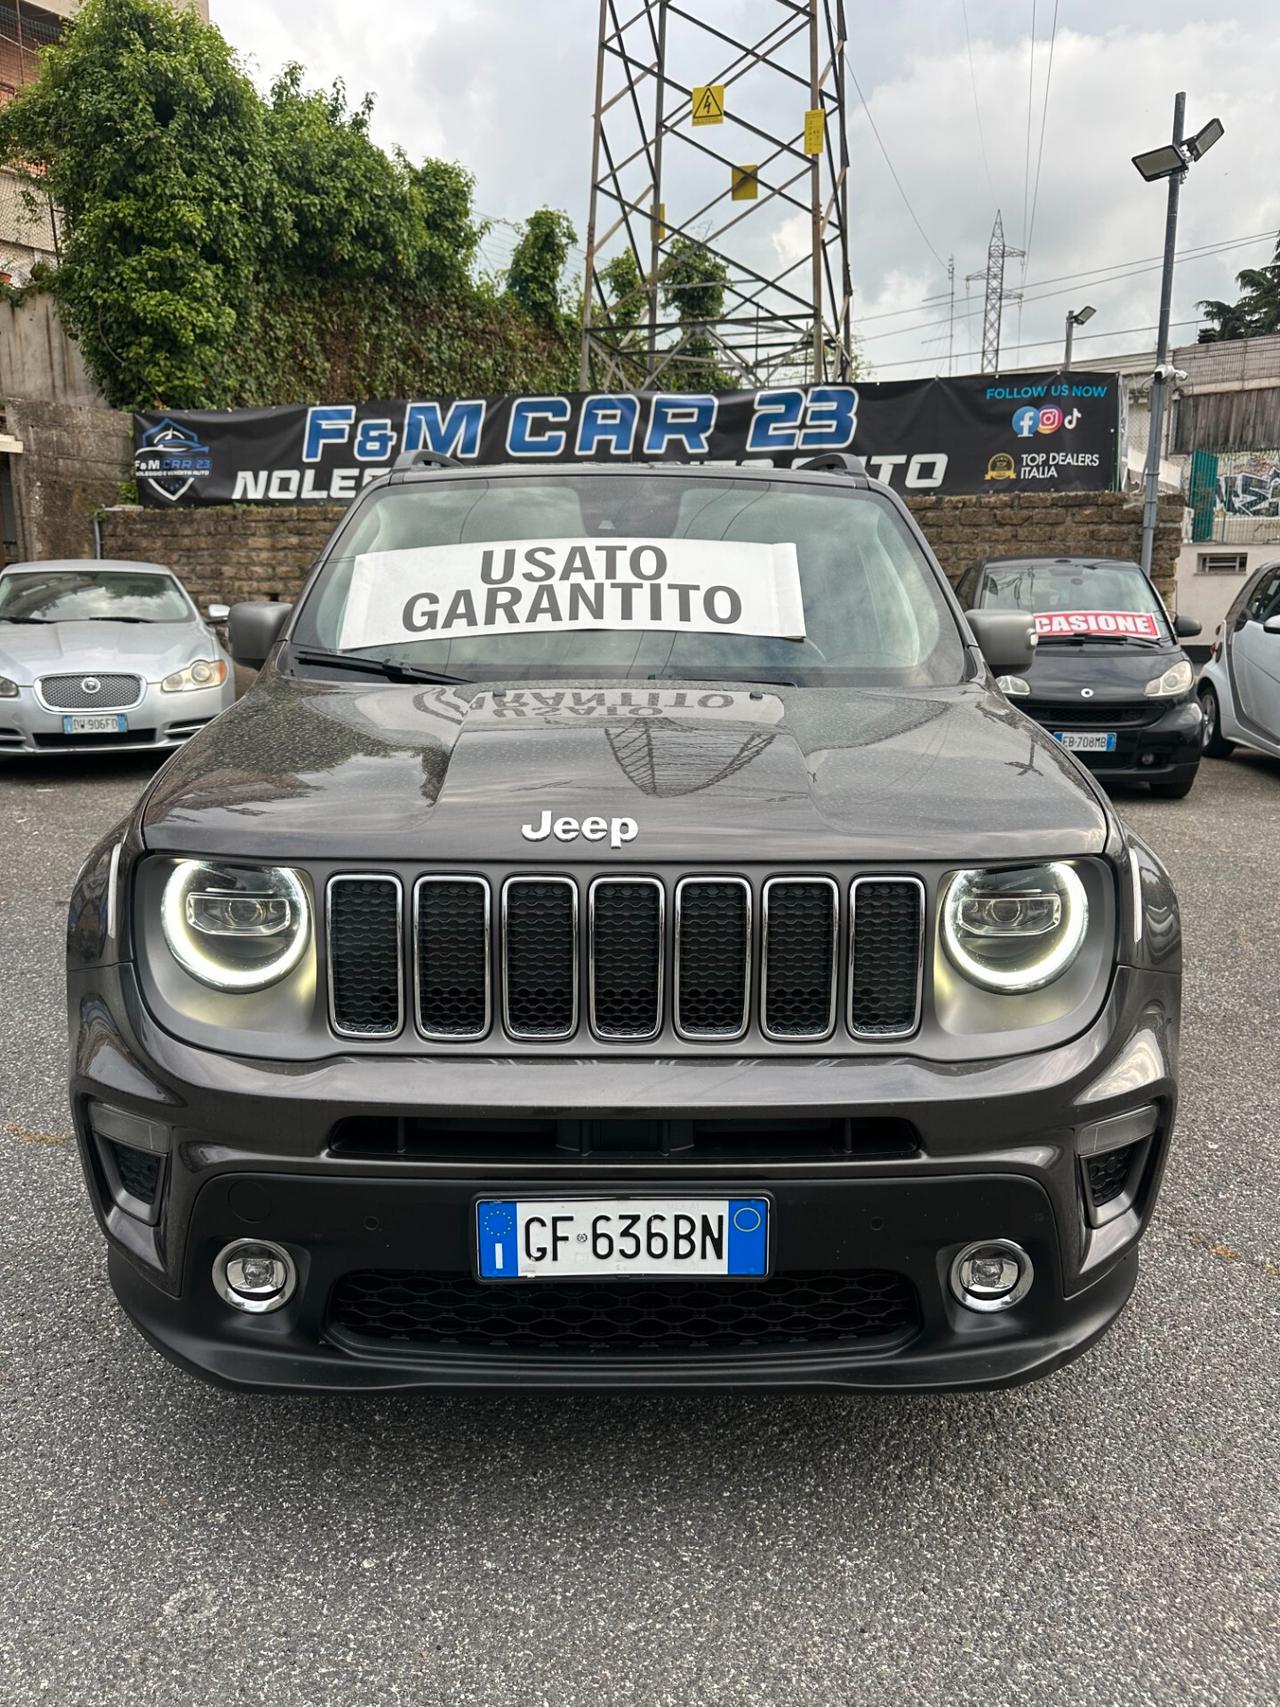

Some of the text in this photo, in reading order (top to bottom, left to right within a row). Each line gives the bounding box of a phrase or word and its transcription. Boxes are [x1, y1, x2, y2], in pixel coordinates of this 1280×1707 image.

[986, 384, 1108, 400] FOLLOW US NOW
[303, 386, 860, 463] F&M CAR 23
[1020, 466, 1058, 480] ITALIA
[1021, 453, 1047, 466] TOP
[1049, 453, 1100, 466] DEALERS
[480, 545, 668, 585] USATO
[402, 583, 742, 632] GARANTITO
[1035, 615, 1151, 633] CASIONE
[521, 810, 639, 849] Jeep
[524, 1215, 575, 1262] GF
[591, 1214, 725, 1261] 636BN
